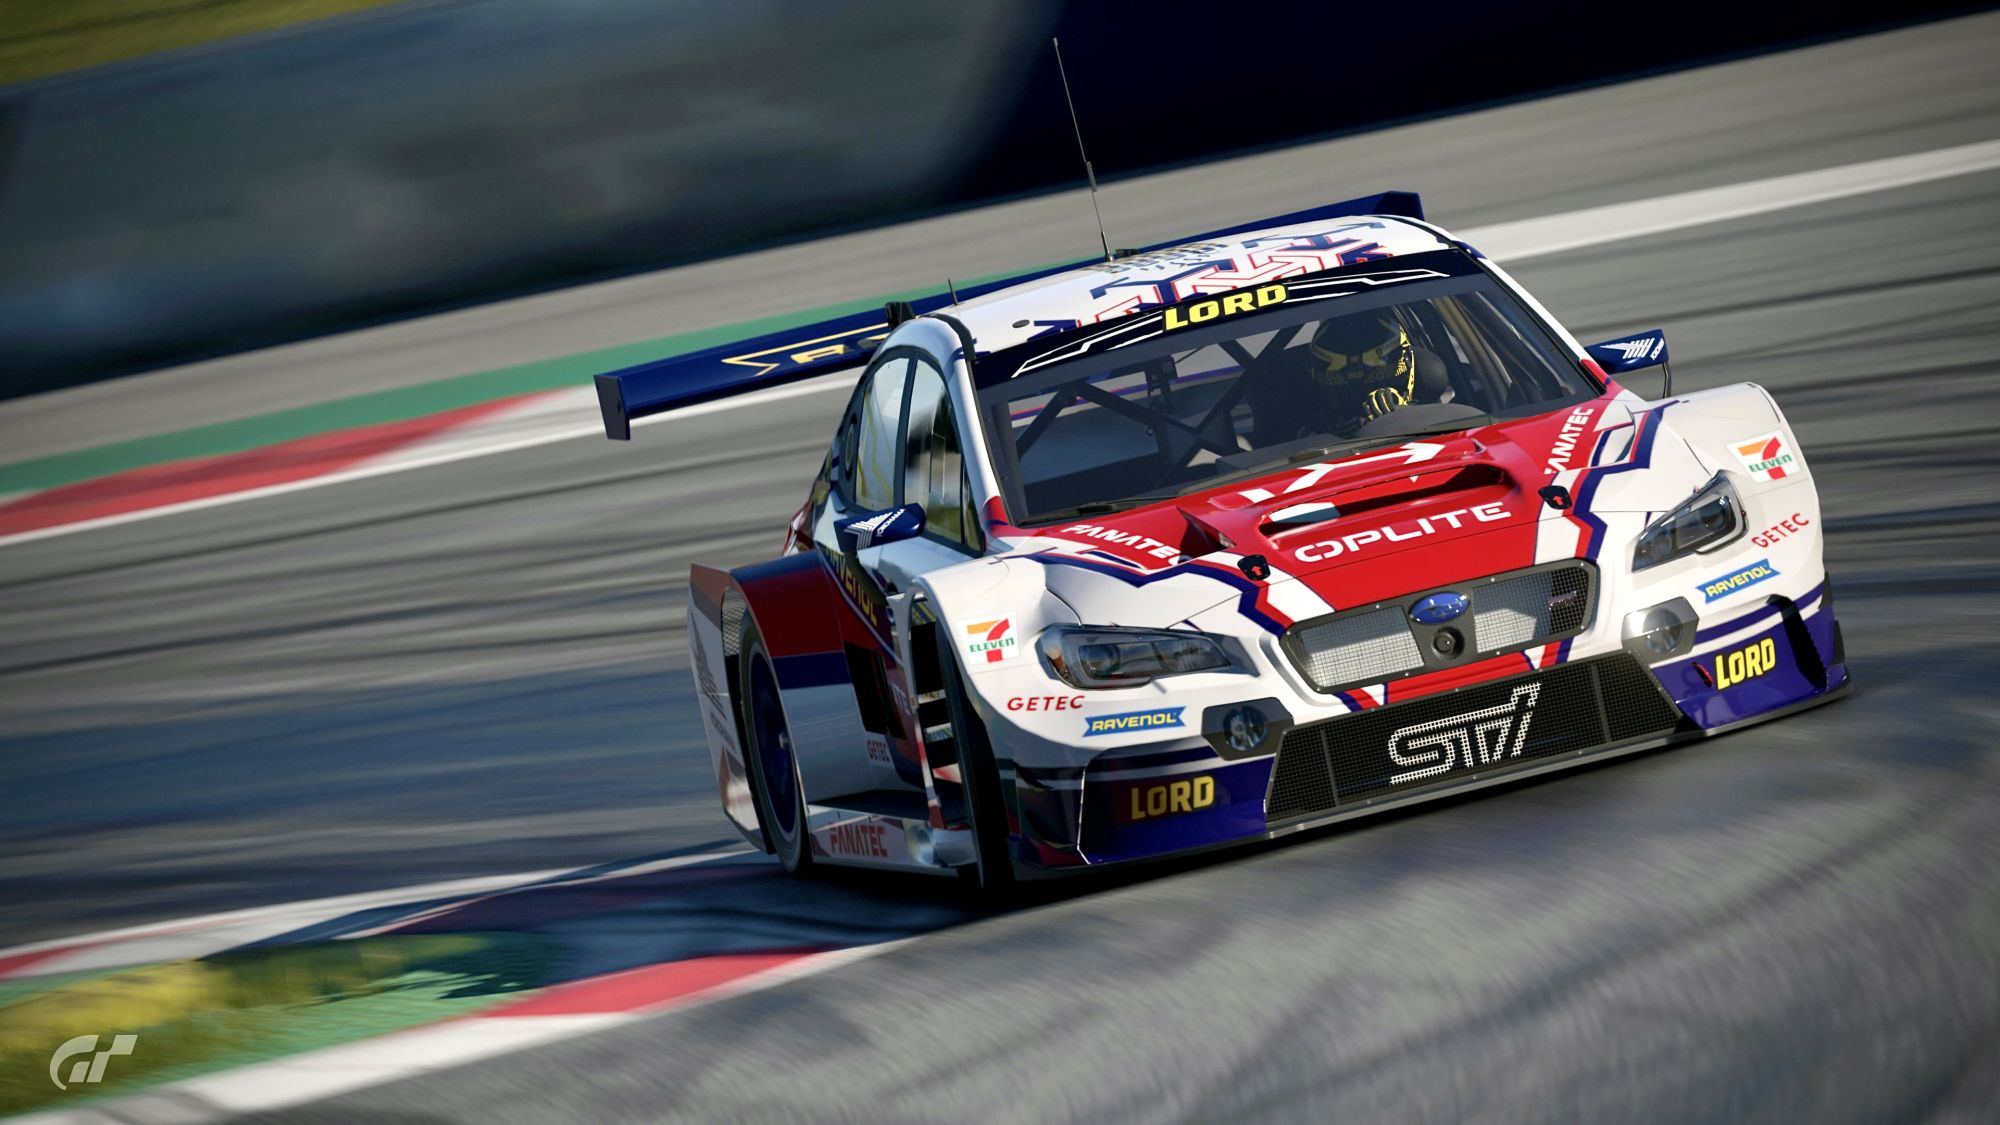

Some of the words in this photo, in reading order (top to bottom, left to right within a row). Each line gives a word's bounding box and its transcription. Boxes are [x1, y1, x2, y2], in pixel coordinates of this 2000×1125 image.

[1165, 284, 1287, 331] LORD
[1294, 501, 1512, 562] OPLITE
[1751, 513, 1810, 548] GETEC
[1705, 564, 1772, 597] RAVENOL
[1715, 637, 1776, 690] LORD
[1007, 695, 1086, 712] GETEC
[1091, 712, 1178, 732] RAVENOL
[1131, 776, 1215, 820] LORD
[828, 821, 888, 858] FANATEC
